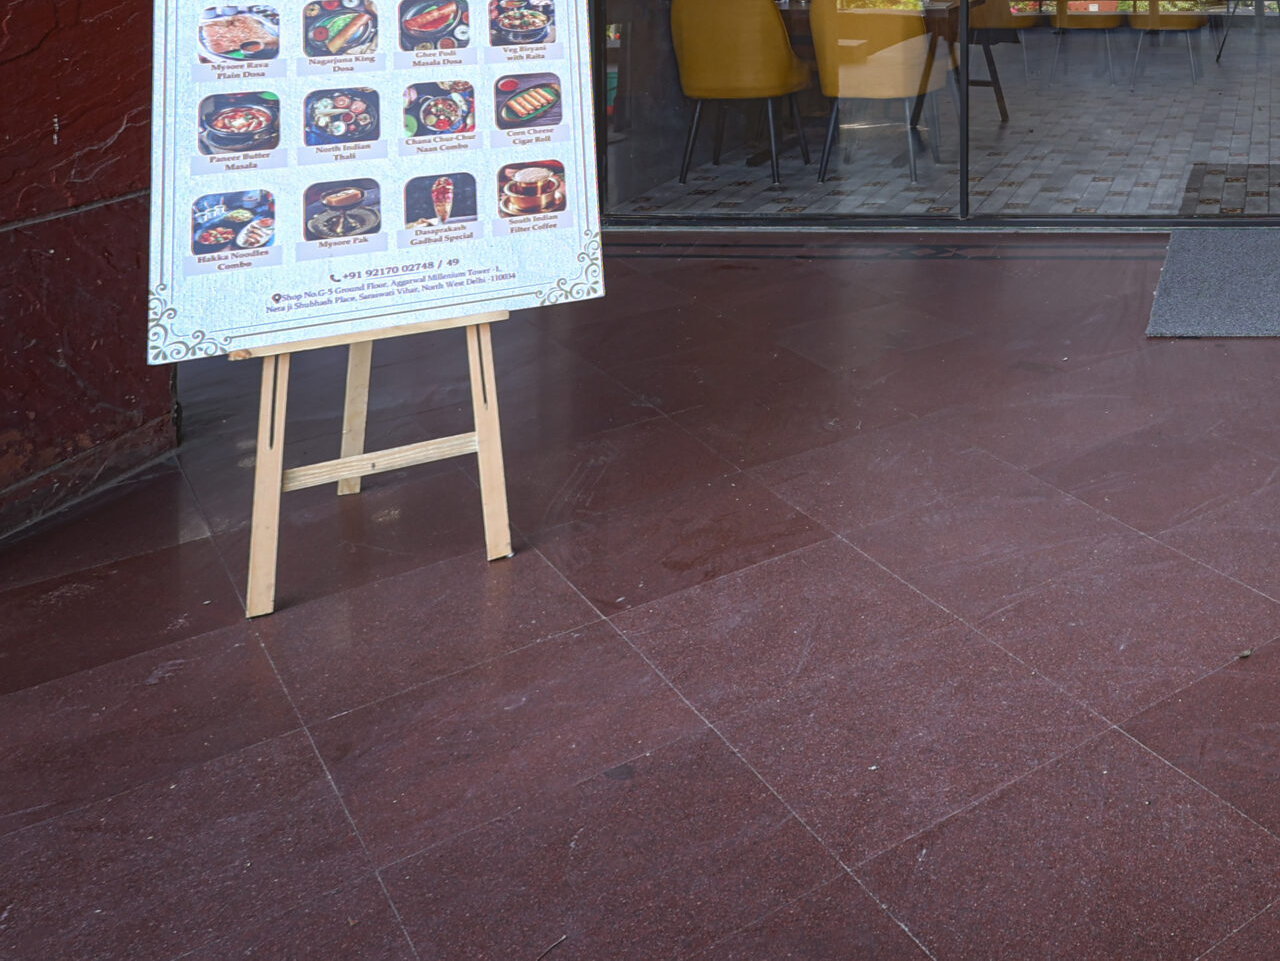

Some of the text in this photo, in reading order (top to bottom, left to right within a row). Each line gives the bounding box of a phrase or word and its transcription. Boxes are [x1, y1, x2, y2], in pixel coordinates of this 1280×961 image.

[316, 143, 371, 153] North Indian
[440, 143, 468, 151] Combo
[209, 152, 270, 163] Paneer Butter
[225, 163, 258, 171] Masala
[509, 214, 558, 225] South Indian
[510, 222, 557, 234] Filter Coffee
[318, 240, 351, 248] Mysore
[410, 232, 473, 246] Gadbad Special
[197, 249, 269, 263] Hakka Noodles
[217, 261, 252, 270] Combo
[343, 258, 459, 279] +91 92170 02748 / 49
[335, 285, 365, 294] Ground
[467, 267, 490, 276] Tower
[422, 283, 443, 291] North
[445, 280, 464, 288] West
[466, 277, 486, 285] Delhi
